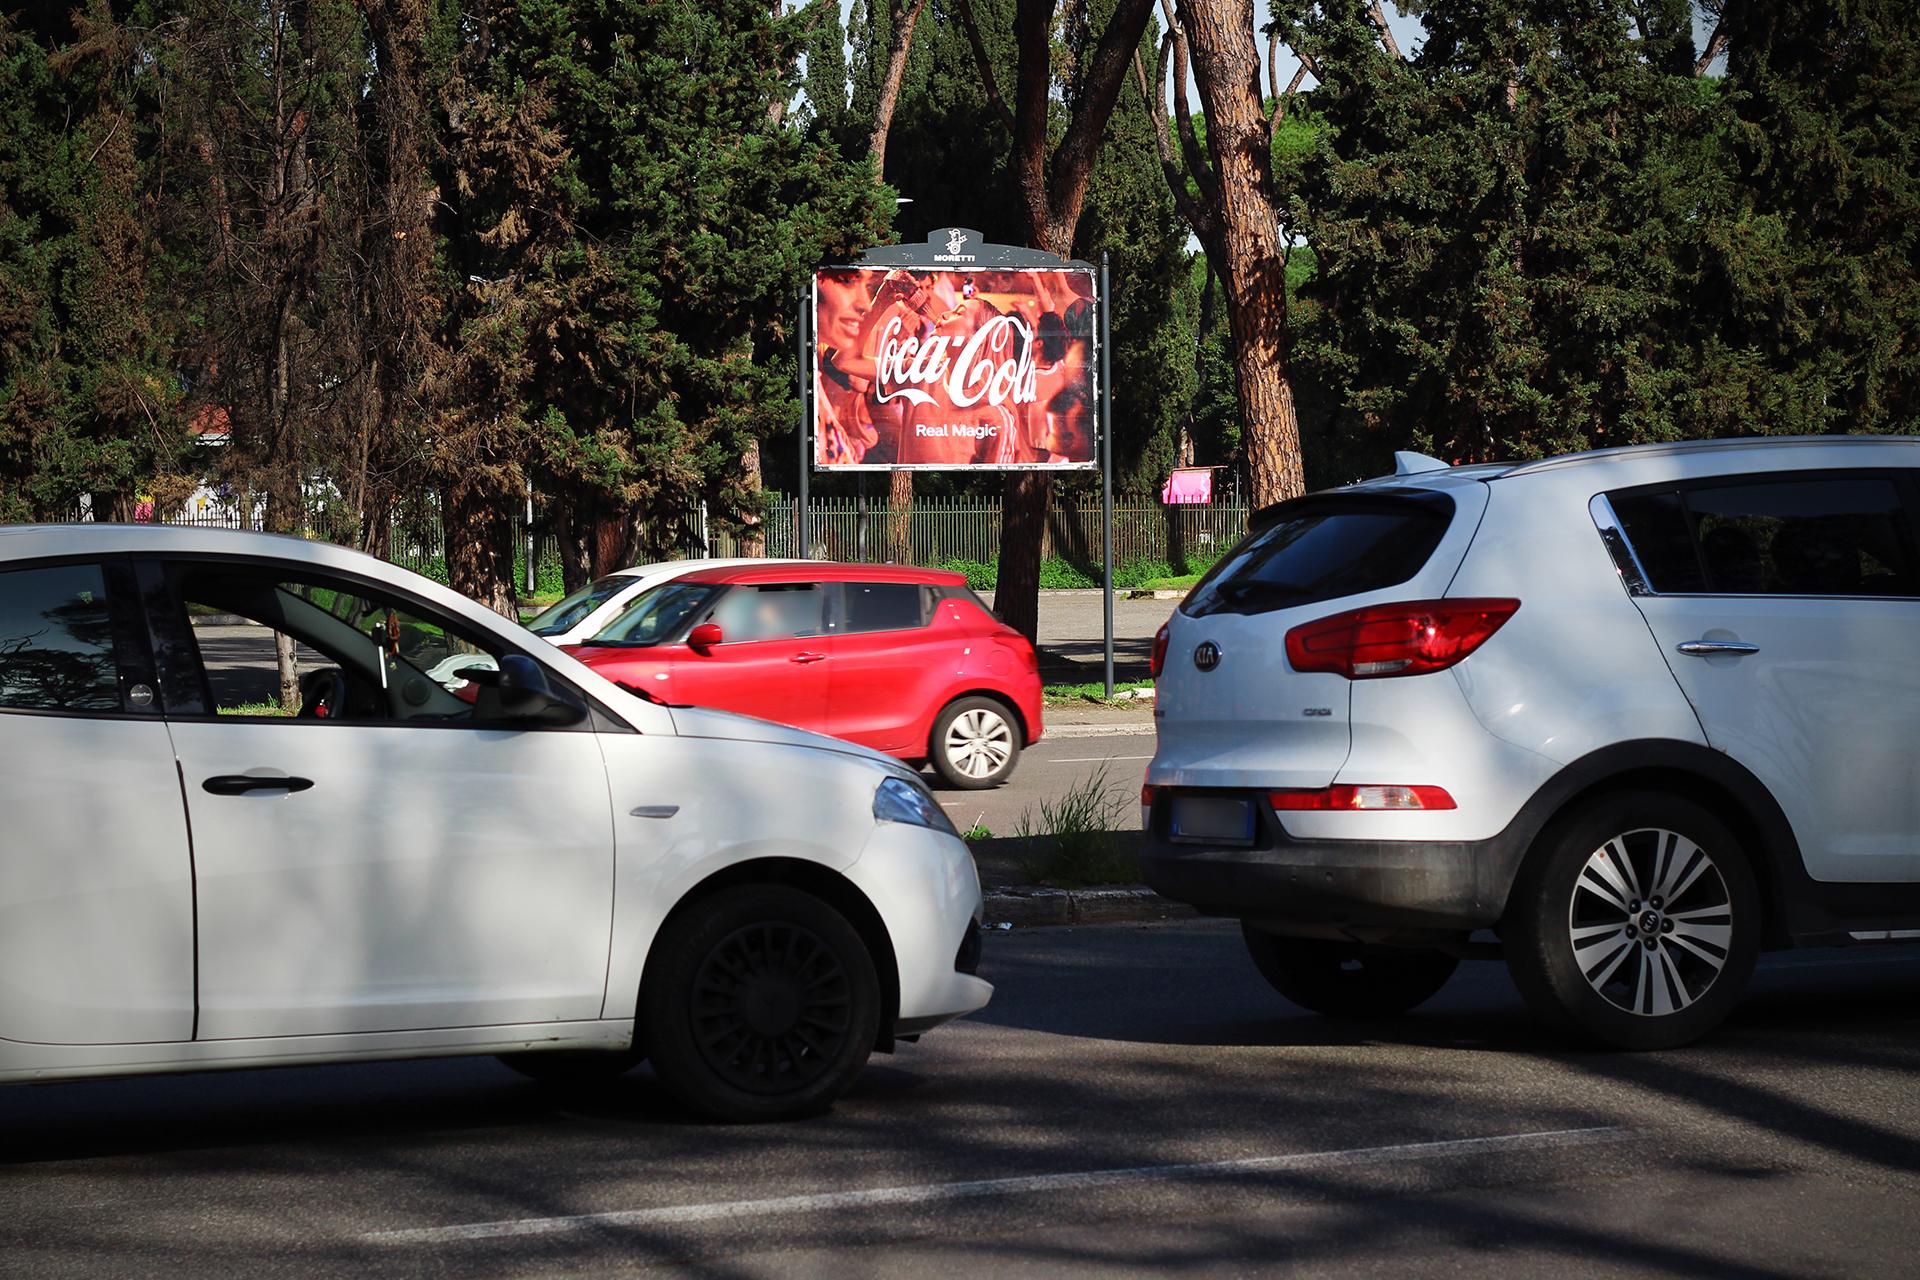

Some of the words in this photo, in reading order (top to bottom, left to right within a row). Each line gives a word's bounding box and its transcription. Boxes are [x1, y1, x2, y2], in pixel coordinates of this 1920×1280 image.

[933, 254, 976, 262] MORETTI
[876, 315, 1037, 408] Coca-Cola
[915, 423, 949, 437] Real
[1195, 647, 1215, 665] KIA
